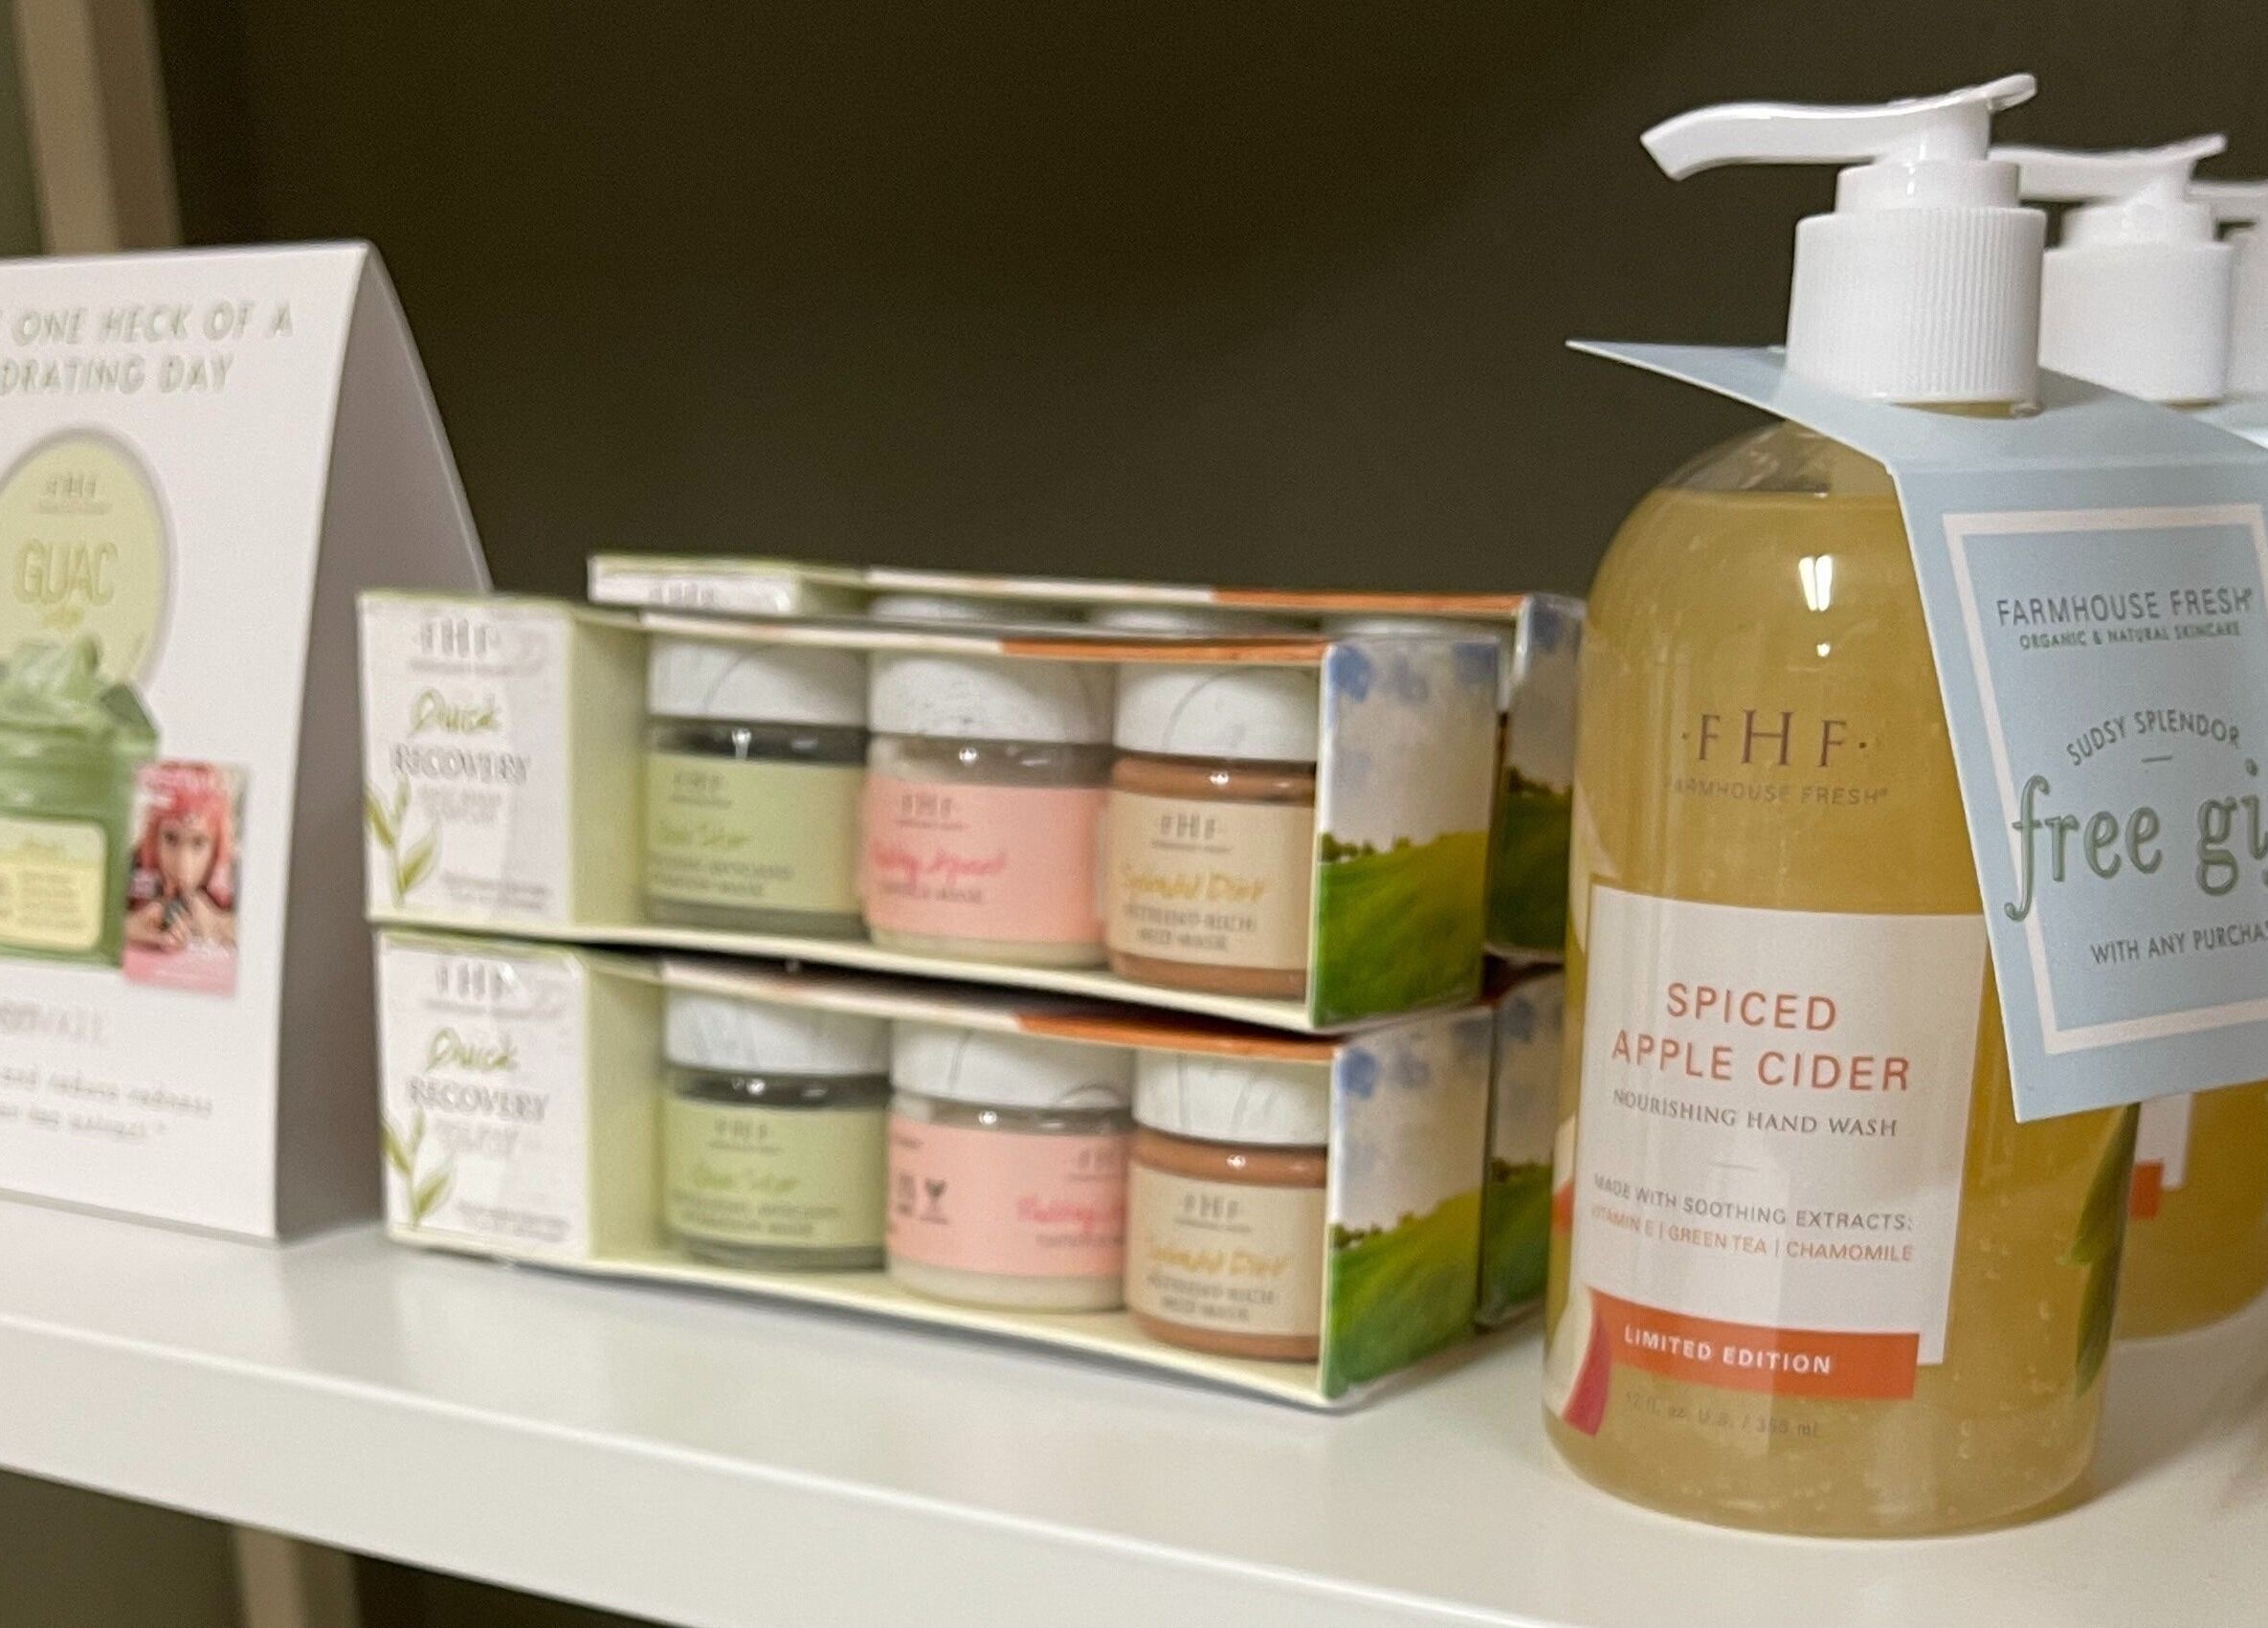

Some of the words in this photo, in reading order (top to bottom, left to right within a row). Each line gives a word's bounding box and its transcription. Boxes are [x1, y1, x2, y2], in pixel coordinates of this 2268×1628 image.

[11, 307, 86, 346] ONE
[98, 303, 195, 344] HECK
[202, 301, 254, 342] OF
[266, 299, 294, 339] A
[158, 354, 233, 394] DAY
[13, 538, 119, 605] GUAC
[1996, 591, 2160, 625] FARMHOUSE
[2019, 631, 2087, 650] ORGANIC
[2093, 631, 2103, 645] &
[2107, 627, 2170, 644] NATURAL
[2174, 620, 2241, 640] SKINCARE
[2067, 716, 2126, 767] SUDSY
[2133, 709, 2240, 749] SPLENDOR
[2004, 774, 2163, 922] free
[2196, 757, 2268, 897] gi
[2091, 940, 2140, 965] WITH
[2148, 932, 2185, 959] ANY
[1666, 982, 1837, 1032] SPICED
[1612, 1029, 1733, 1081] APPLE
[1757, 1051, 1910, 1092] CIDER
[1612, 1088, 1738, 1126] NOURISHING
[1746, 1110, 1818, 1134] HAND
[1828, 1117, 1898, 1138] WASH
[1593, 1173, 1631, 1200] MADE
[1634, 1186, 1678, 1208] WITH
[1682, 1196, 1787, 1226] SOOTHING
[1644, 1219, 1656, 1238] E
[1668, 1225, 1728, 1250] GREEN
[1733, 1237, 1768, 1255] TEA
[1786, 1239, 1913, 1262] CHAMOMILE
[1624, 1325, 1712, 1361] LIMITED
[1723, 1345, 1833, 1375] EDITION
